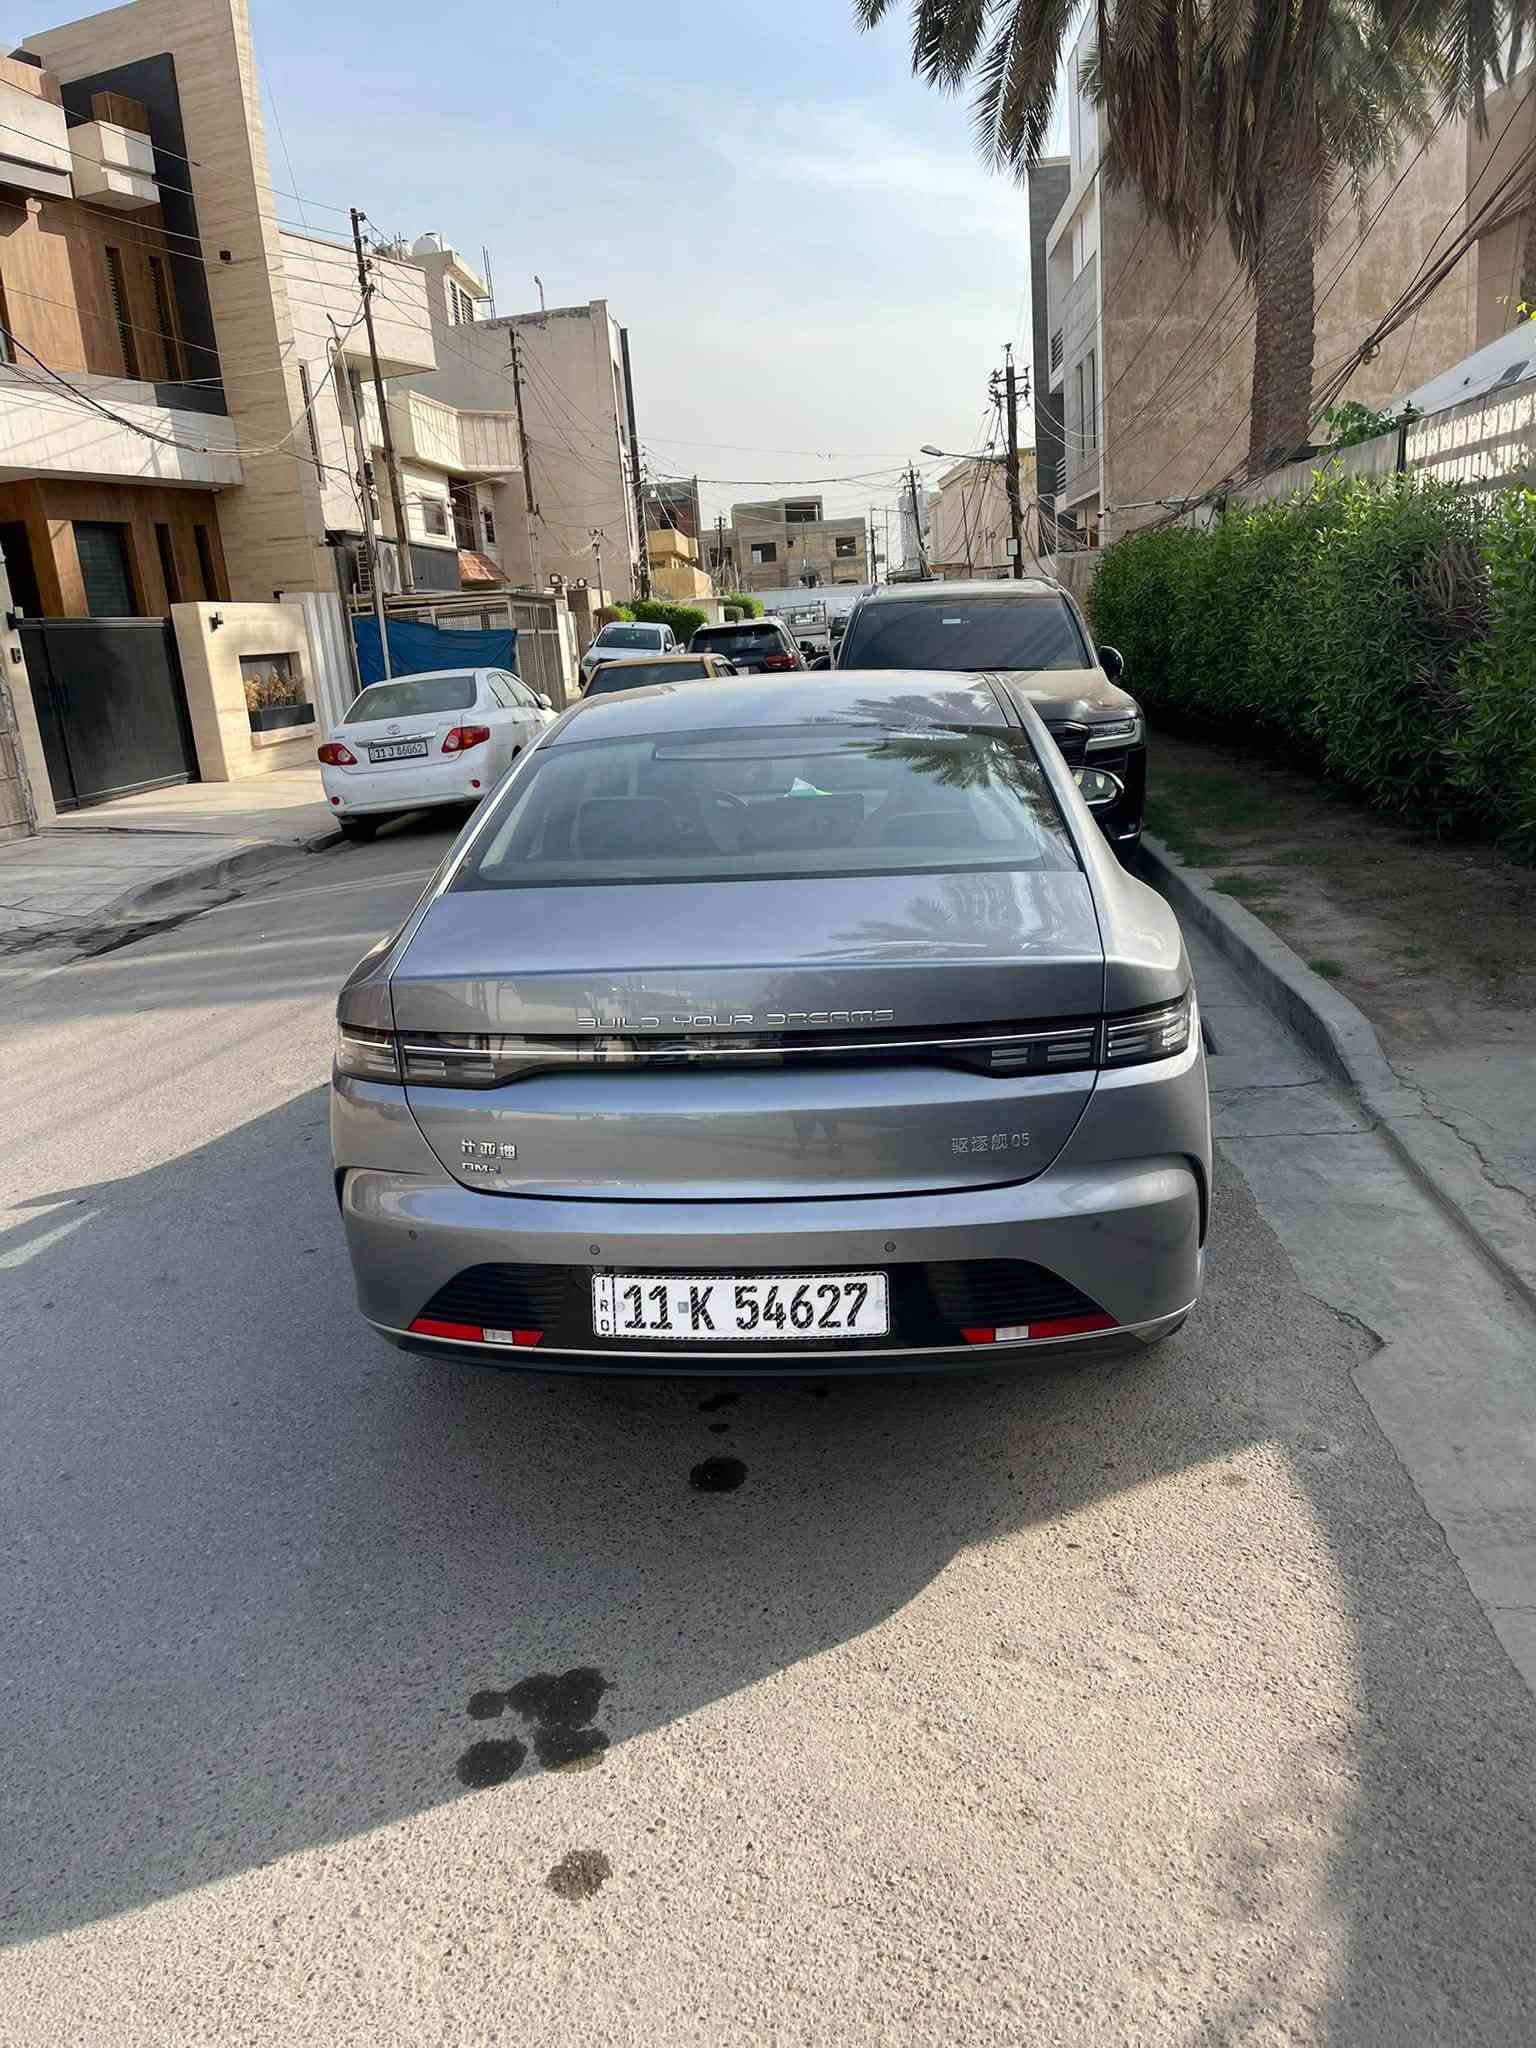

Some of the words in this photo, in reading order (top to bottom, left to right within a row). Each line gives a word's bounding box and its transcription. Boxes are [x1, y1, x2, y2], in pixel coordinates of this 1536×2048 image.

[375, 748, 385, 758] 11
[577, 1016, 660, 1029] BUILD
[673, 1014, 754, 1027] YOUR
[766, 1009, 894, 1026] DREAMS
[1012, 1132, 1030, 1148] 05
[623, 1284, 673, 1330] 11
[689, 1285, 716, 1330] K
[734, 1282, 868, 1330] 54627
